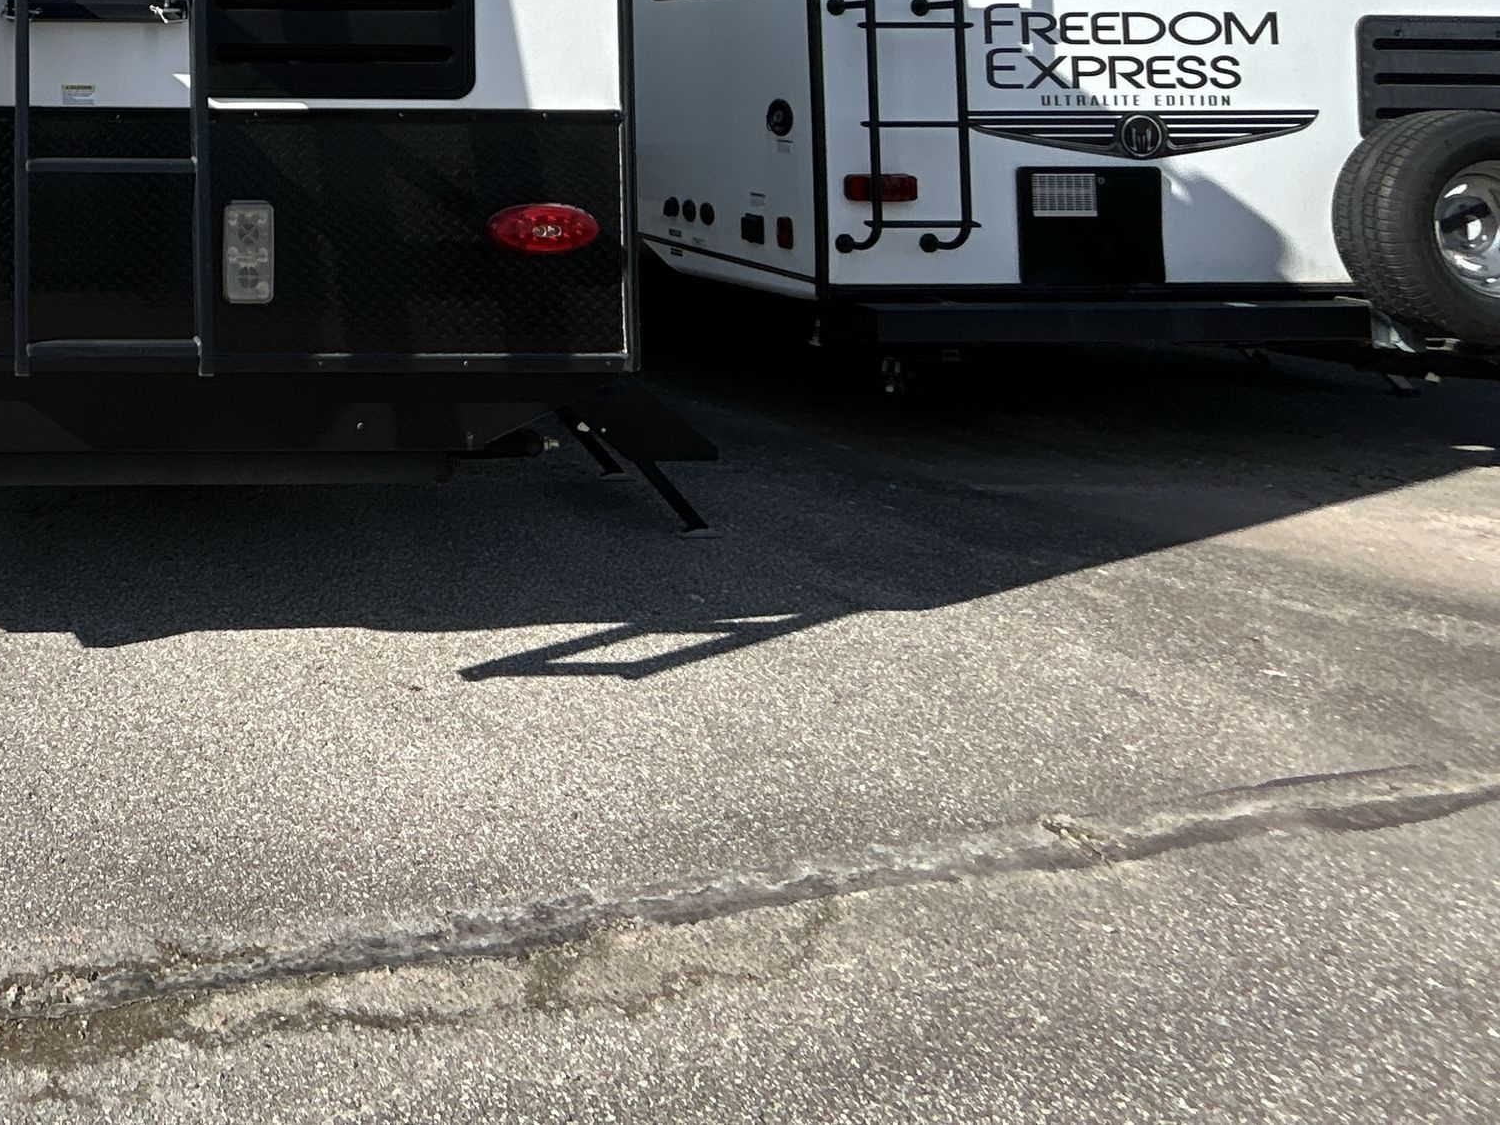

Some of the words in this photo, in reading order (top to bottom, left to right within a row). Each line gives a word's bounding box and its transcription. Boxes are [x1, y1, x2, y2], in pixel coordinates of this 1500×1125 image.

[983, 3, 1279, 46] FREEDOM
[985, 47, 1242, 90] EXPRESS
[1041, 94, 1141, 107] ULTRALITE
[1154, 94, 1232, 107] EDITION
